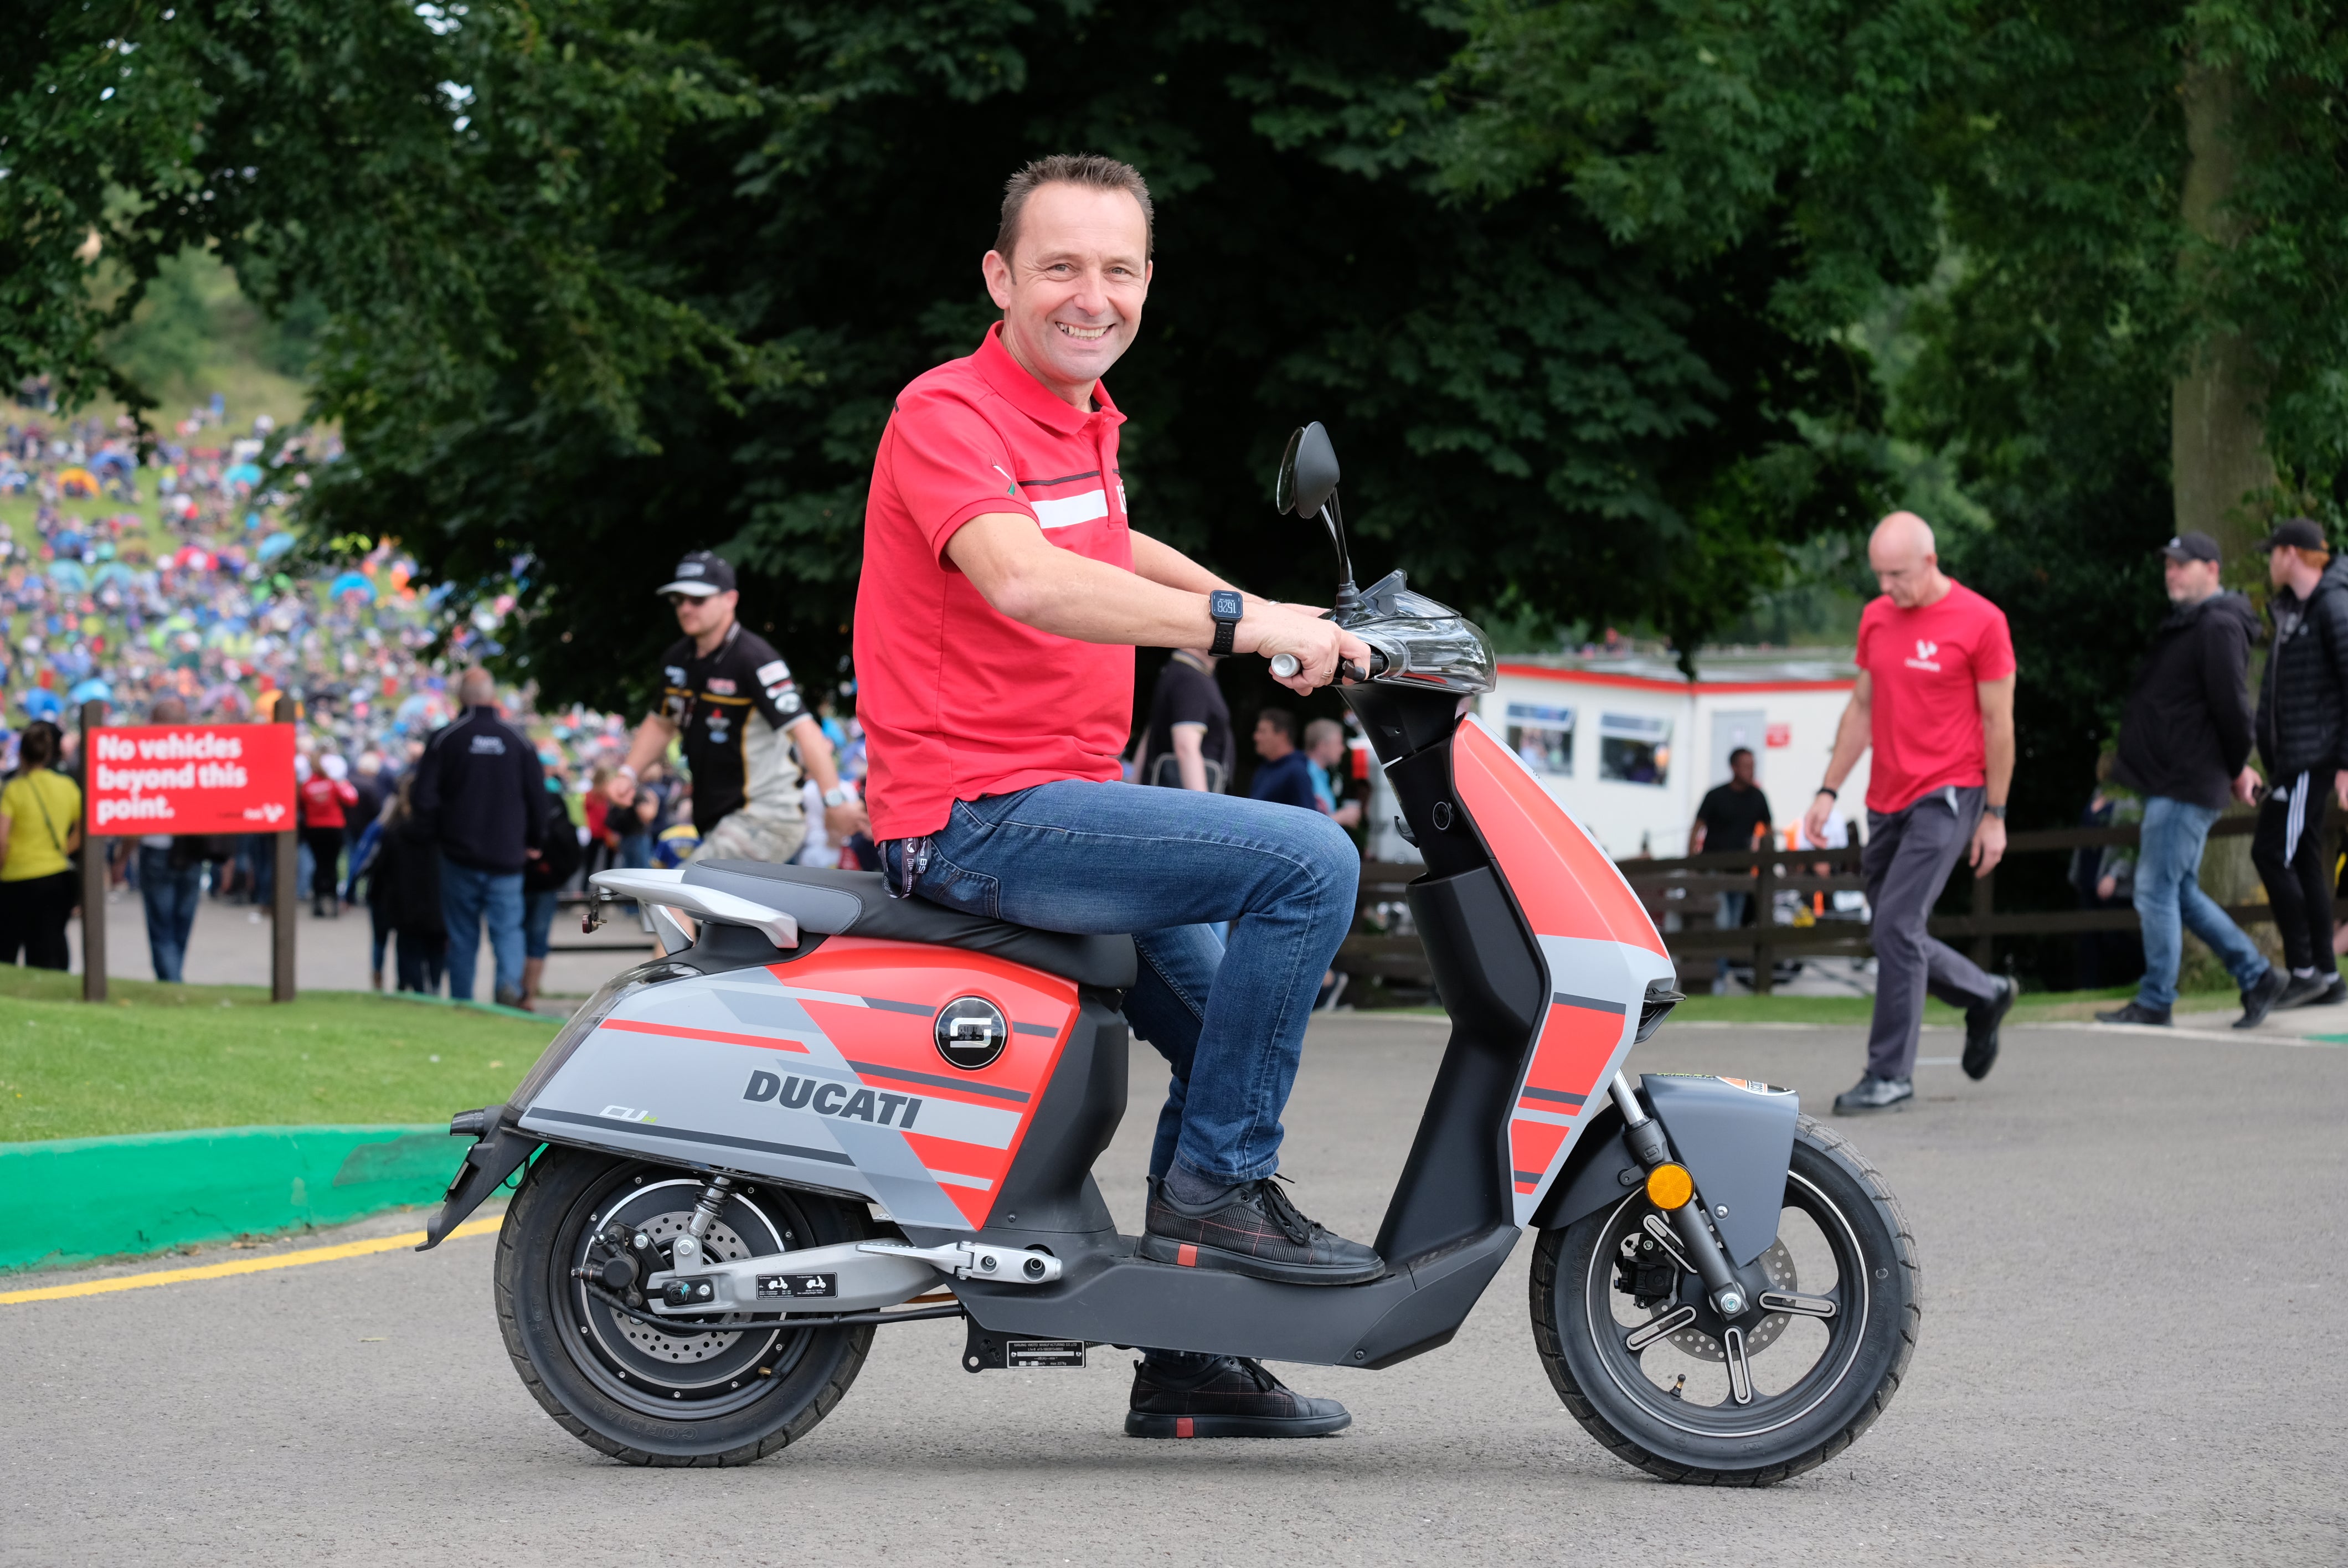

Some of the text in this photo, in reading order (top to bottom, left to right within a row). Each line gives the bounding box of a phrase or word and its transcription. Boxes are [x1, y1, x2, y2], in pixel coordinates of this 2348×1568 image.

[1218, 601, 1237, 613] 1526
[96, 732, 243, 761] No vehicles
[96, 761, 248, 796] beyond this
[96, 795, 175, 825] point.
[743, 1070, 923, 1129] DUCATI
[585, 1395, 699, 1441] CORDIAL
